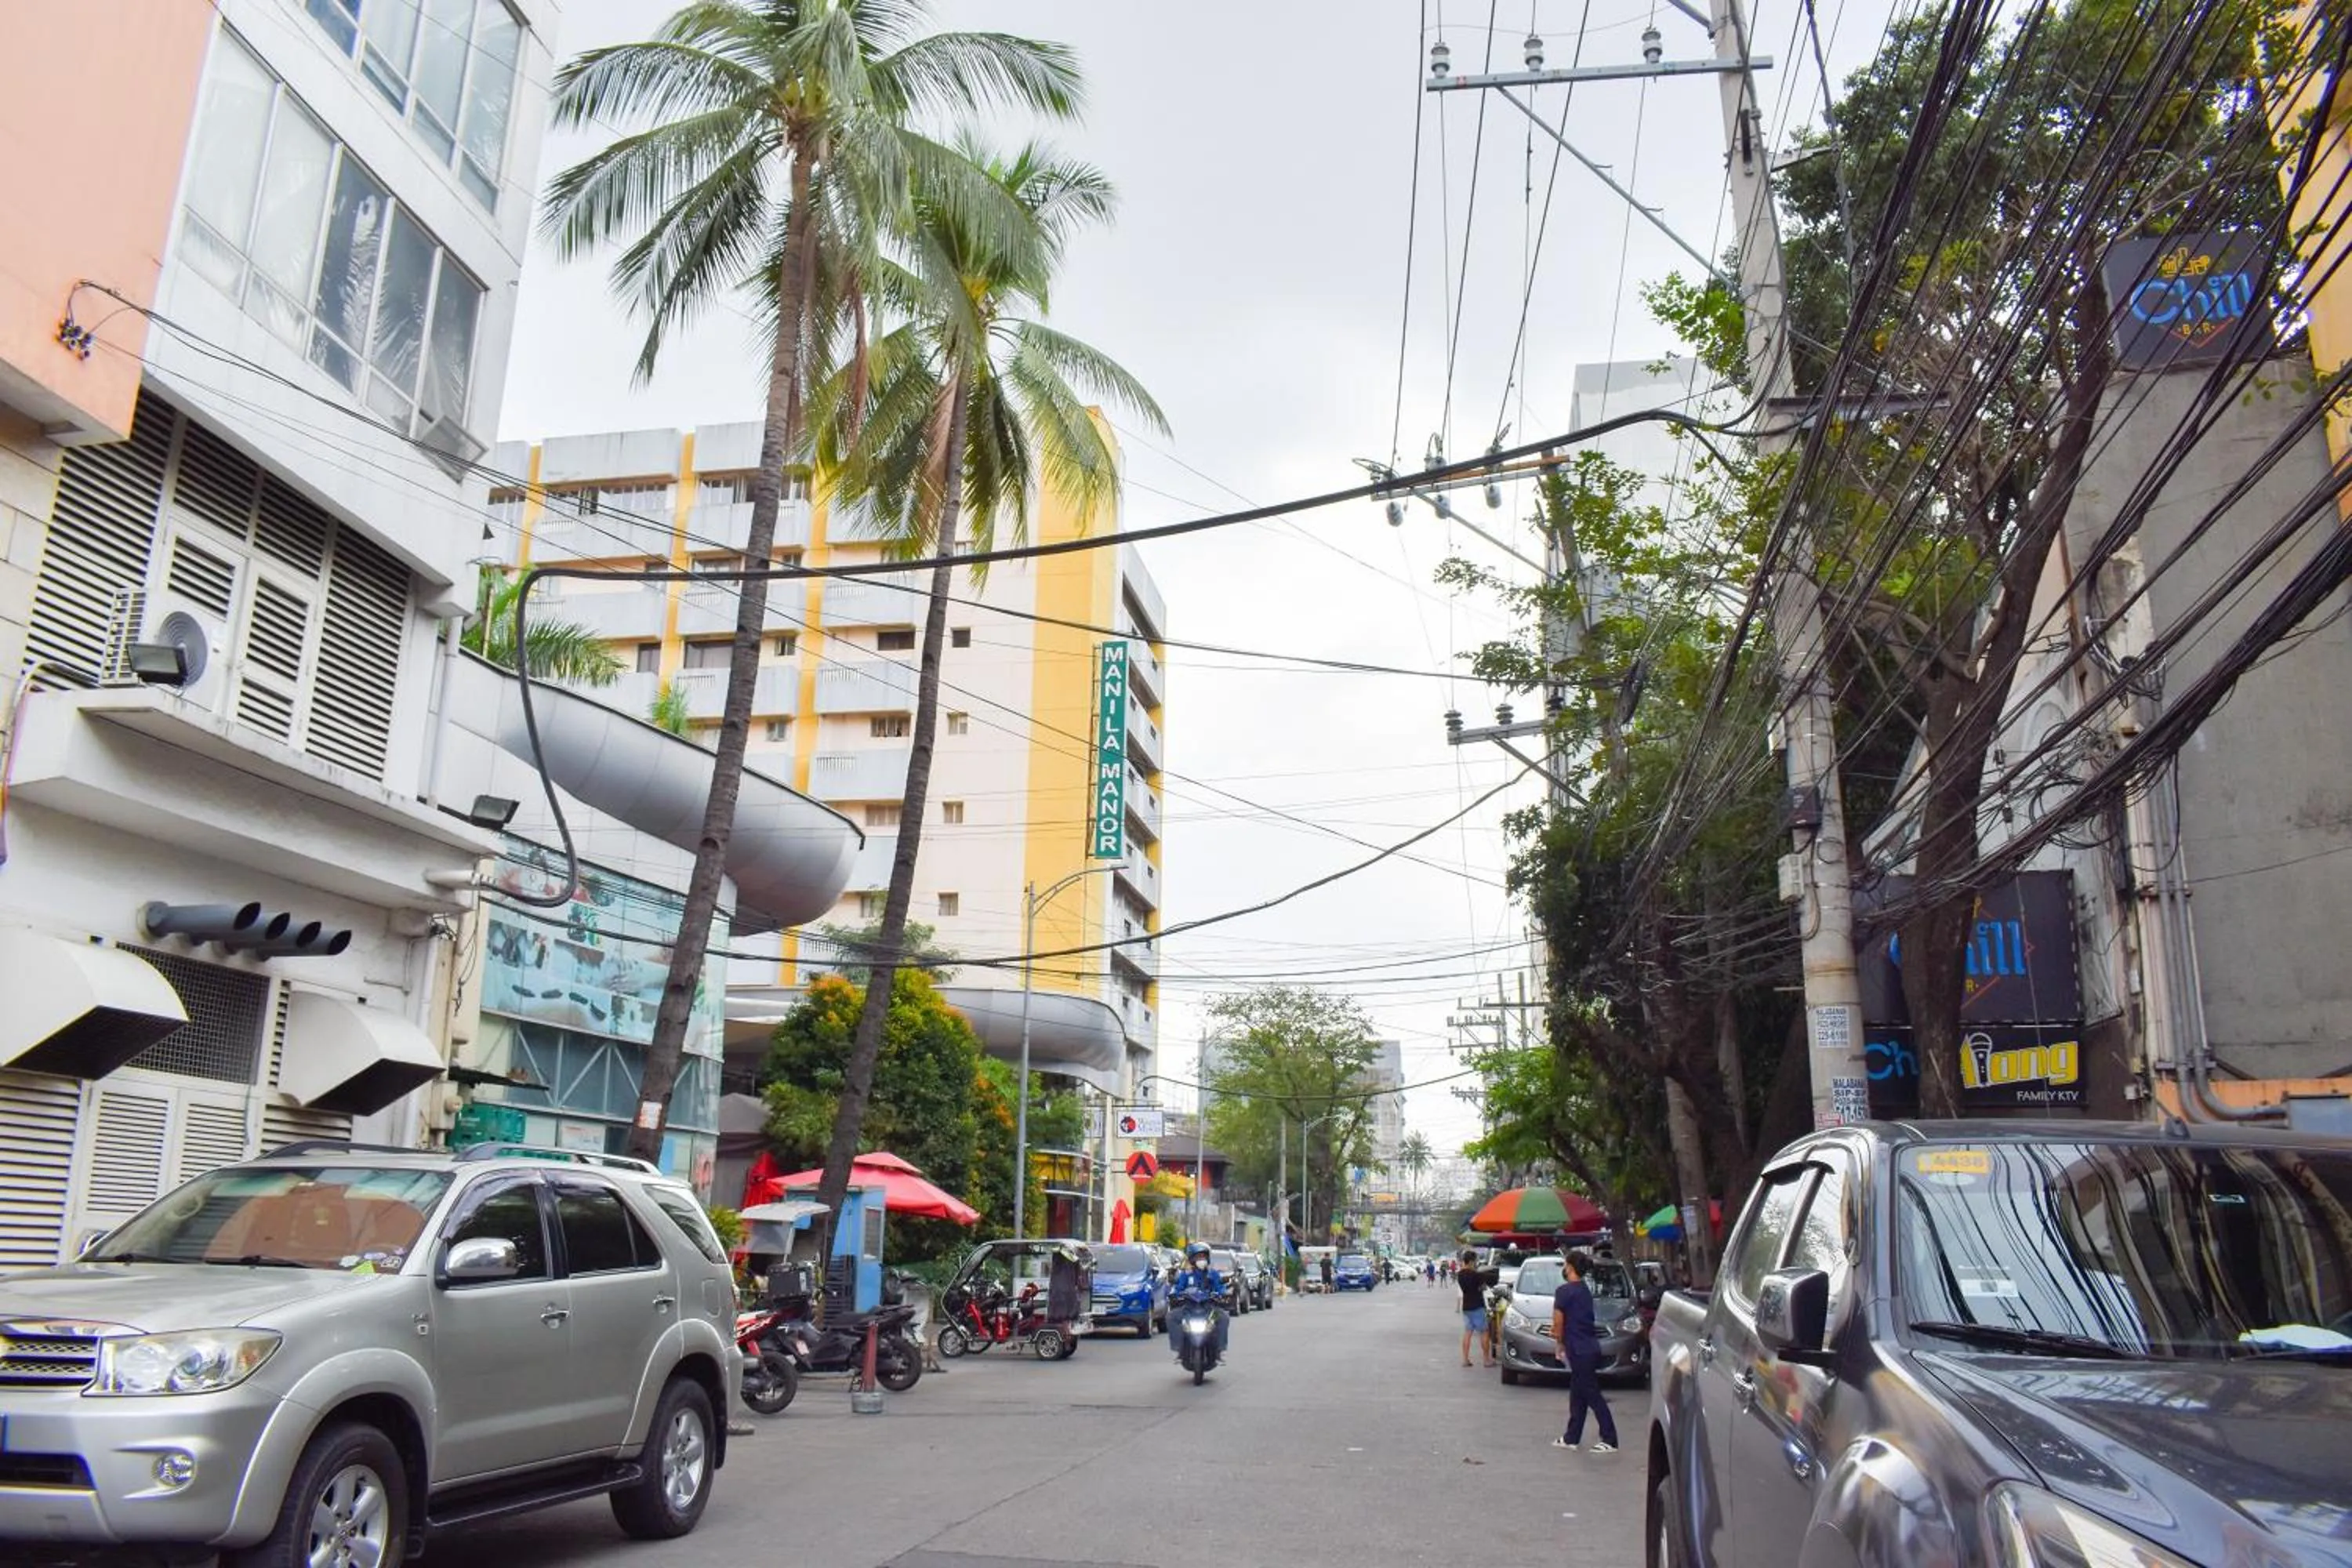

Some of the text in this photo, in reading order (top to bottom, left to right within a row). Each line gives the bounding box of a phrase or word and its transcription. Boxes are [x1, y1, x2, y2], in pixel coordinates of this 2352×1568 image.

[2129, 272, 2253, 324] Chill
[1099, 647, 1123, 851] MANILA MANOR
[2016, 1091, 2079, 1101] FAMILY KTV
